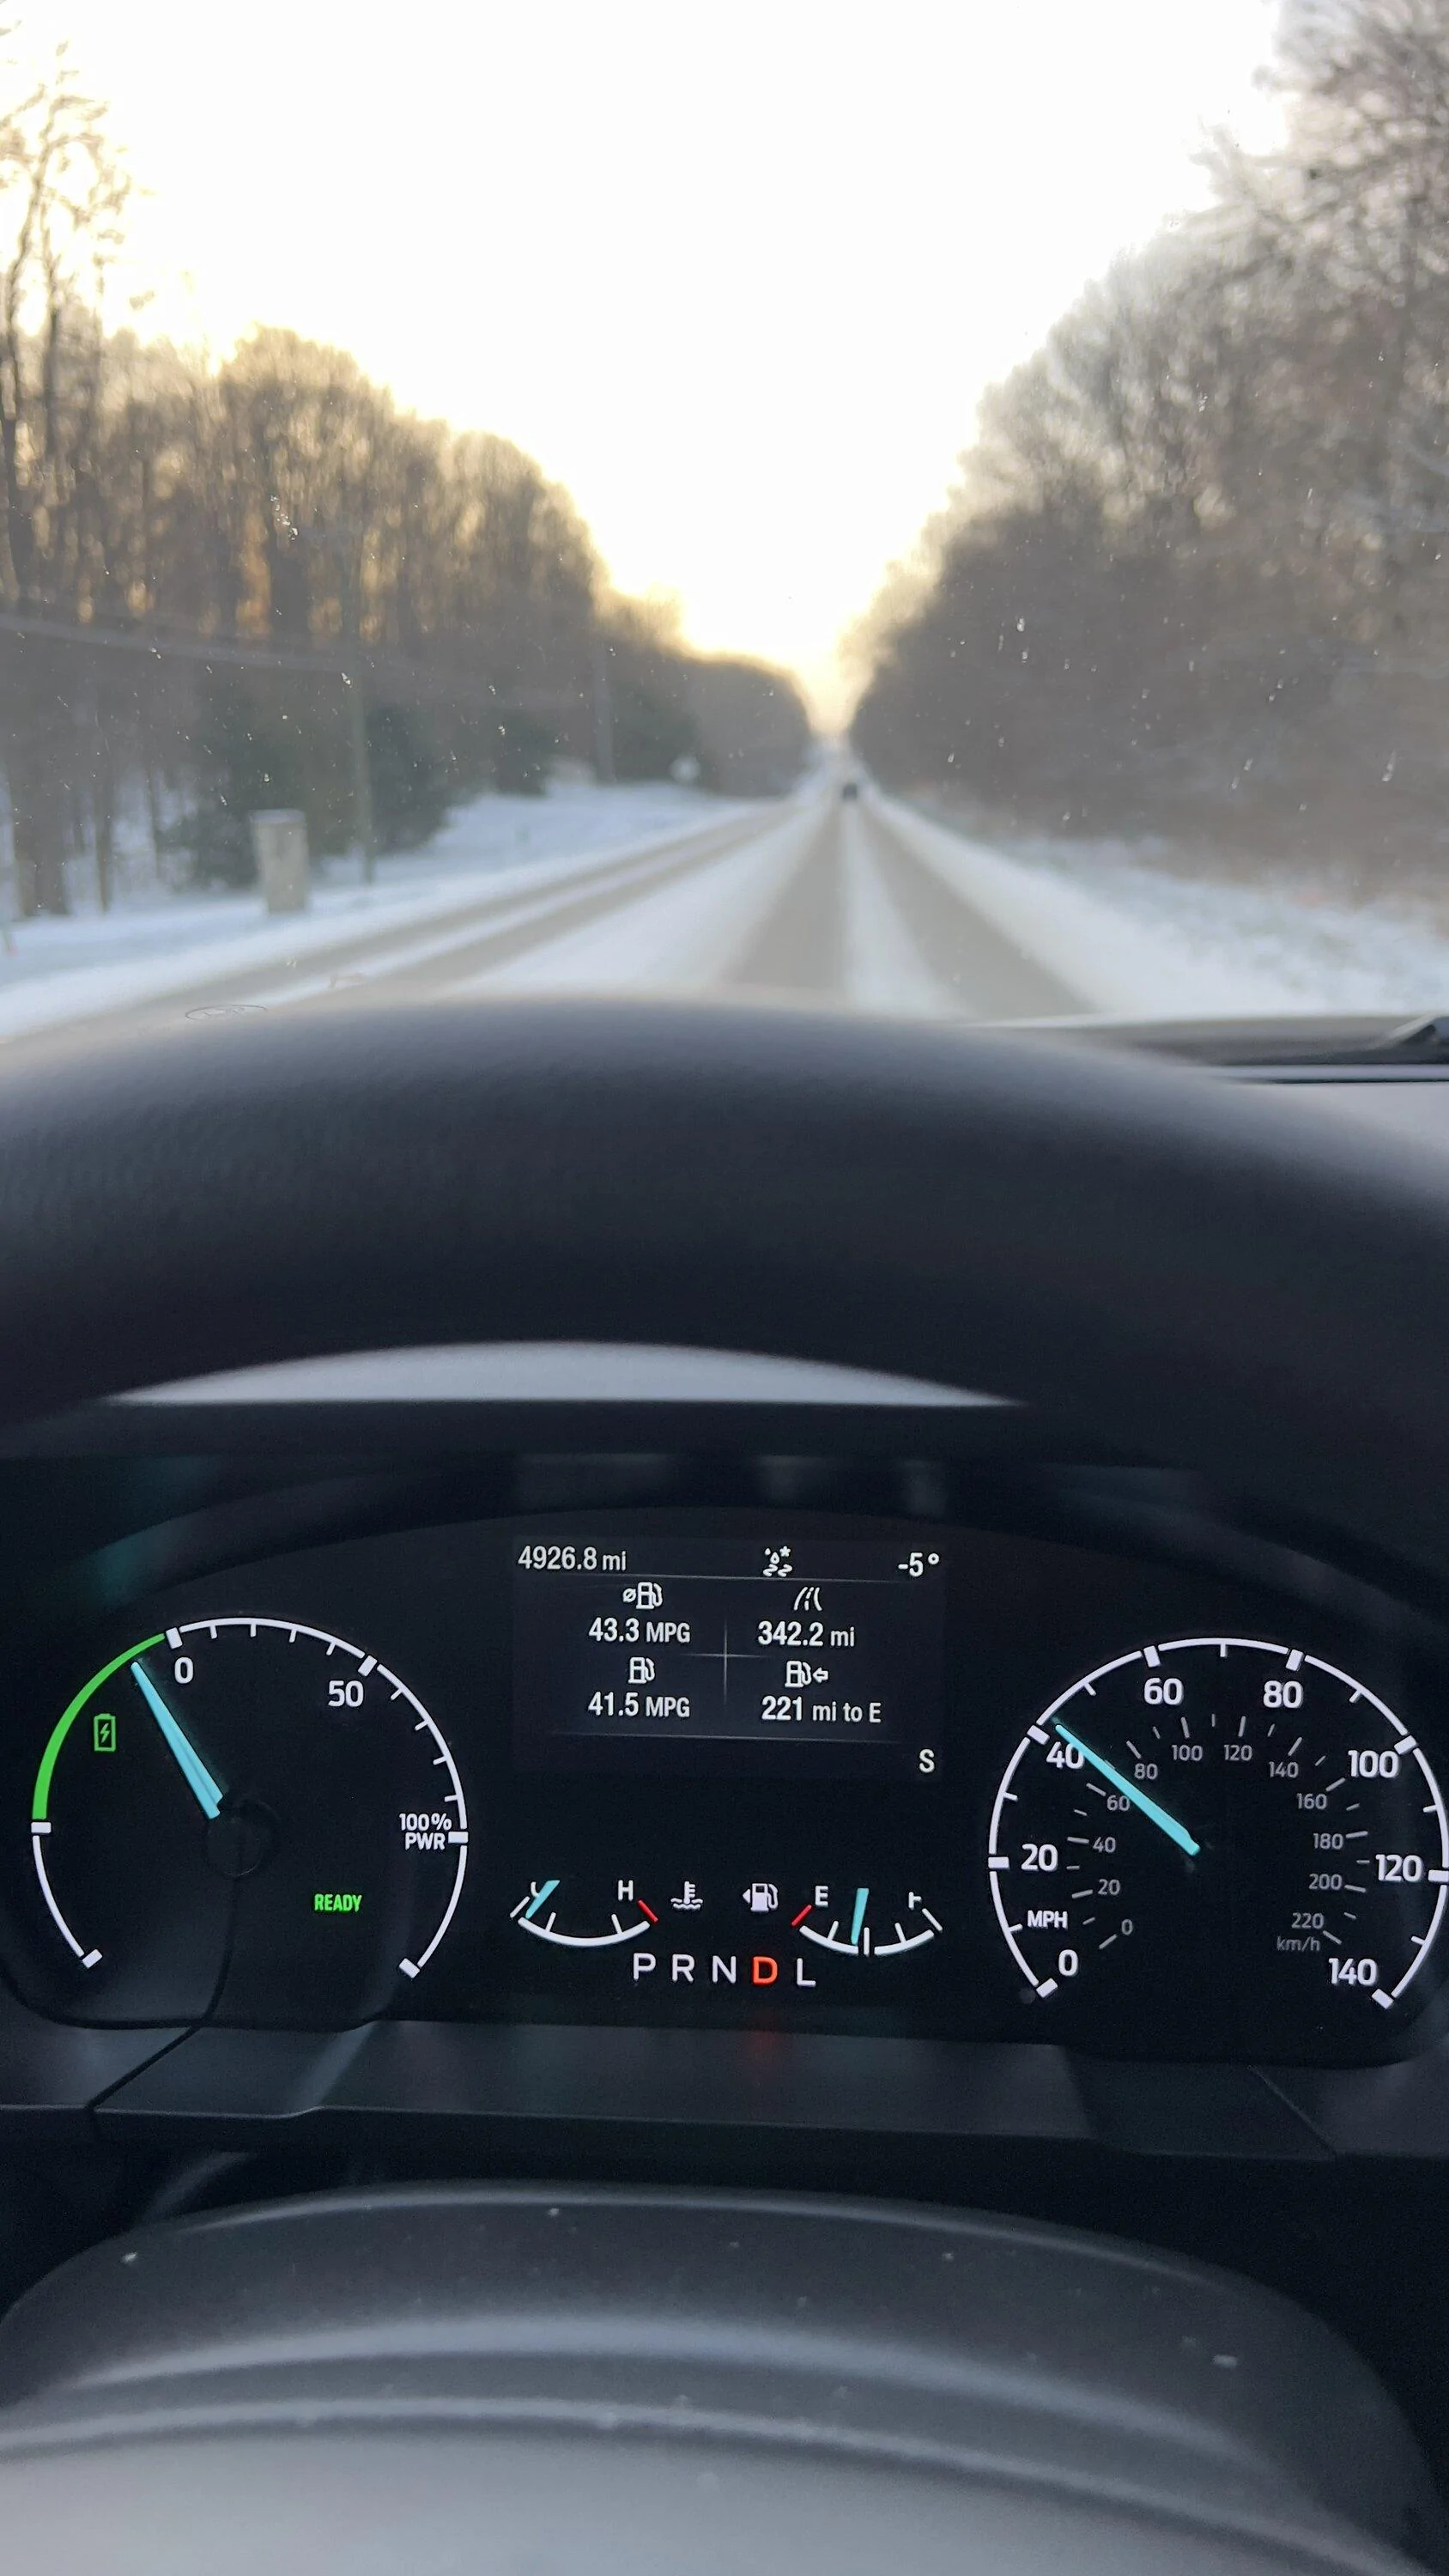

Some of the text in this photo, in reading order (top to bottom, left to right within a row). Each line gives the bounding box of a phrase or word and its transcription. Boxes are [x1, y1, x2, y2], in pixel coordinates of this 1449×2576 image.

[518, 1545, 627, 1571] 4926.8 mi
[588, 1617, 691, 1643] 43.3 MPG
[757, 1620, 855, 1647] 342.2 mi
[174, 1656, 194, 1684] 0
[328, 1680, 364, 1708] 50
[1143, 1677, 1184, 1705] 60
[1263, 1680, 1304, 1709] 80
[587, 1691, 690, 1718] 41.5 MPG
[761, 1695, 882, 1723] 221 mi to E
[919, 1748, 935, 1773] S
[1046, 1744, 1085, 1770] 40
[1171, 1744, 1203, 1762] 100
[1223, 1744, 1253, 1761] 120
[1348, 1748, 1400, 1778] 100
[1133, 1763, 1159, 1780] 80
[1269, 1761, 1299, 1778] 140
[1106, 1791, 1131, 1812] 60
[1296, 1792, 1328, 1810] 160
[398, 1813, 452, 1832] 100%
[404, 1832, 446, 1850] PWR
[1092, 1836, 1117, 1853] 40
[1313, 1832, 1344, 1850] 180
[1021, 1843, 1058, 1872] 20
[1375, 1854, 1423, 1883] 120
[617, 1880, 634, 1901] H
[1097, 1878, 1121, 1896] 20
[1308, 1873, 1343, 1891] 200
[314, 1893, 362, 1912] READY
[815, 1885, 829, 1907] E
[1027, 1910, 1068, 1929] MPH
[1121, 1918, 1133, 1935] 0
[1291, 1912, 1325, 1929] 220
[1276, 1935, 1321, 1952] km/h
[633, 1953, 816, 1987] P R N D L
[1058, 1949, 1079, 1977] 0
[1328, 1958, 1378, 1986] 140
